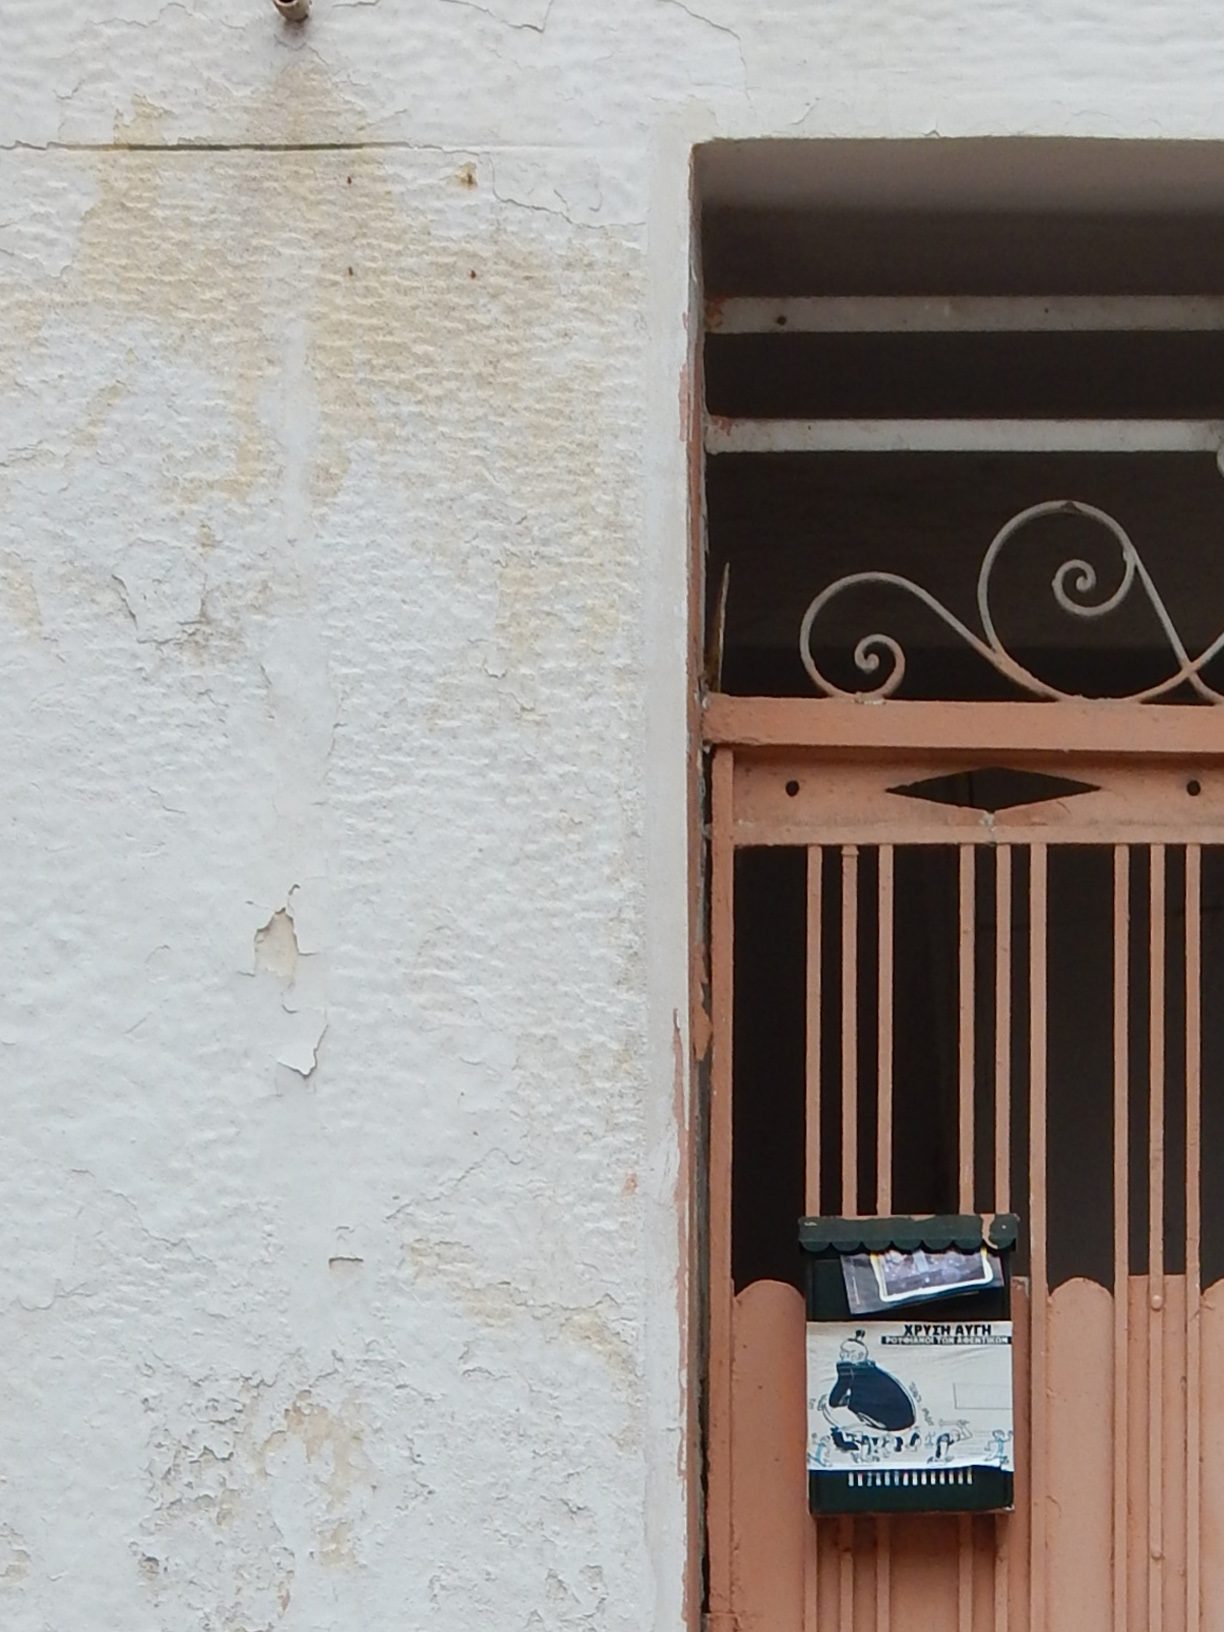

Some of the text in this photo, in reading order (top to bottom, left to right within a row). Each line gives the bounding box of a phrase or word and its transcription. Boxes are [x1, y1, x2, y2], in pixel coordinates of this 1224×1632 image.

[904, 1324, 991, 1335] ΧΡΥΣΗ ΑΥΓΗ
[937, 1336, 954, 1344] ΤΩΝ
